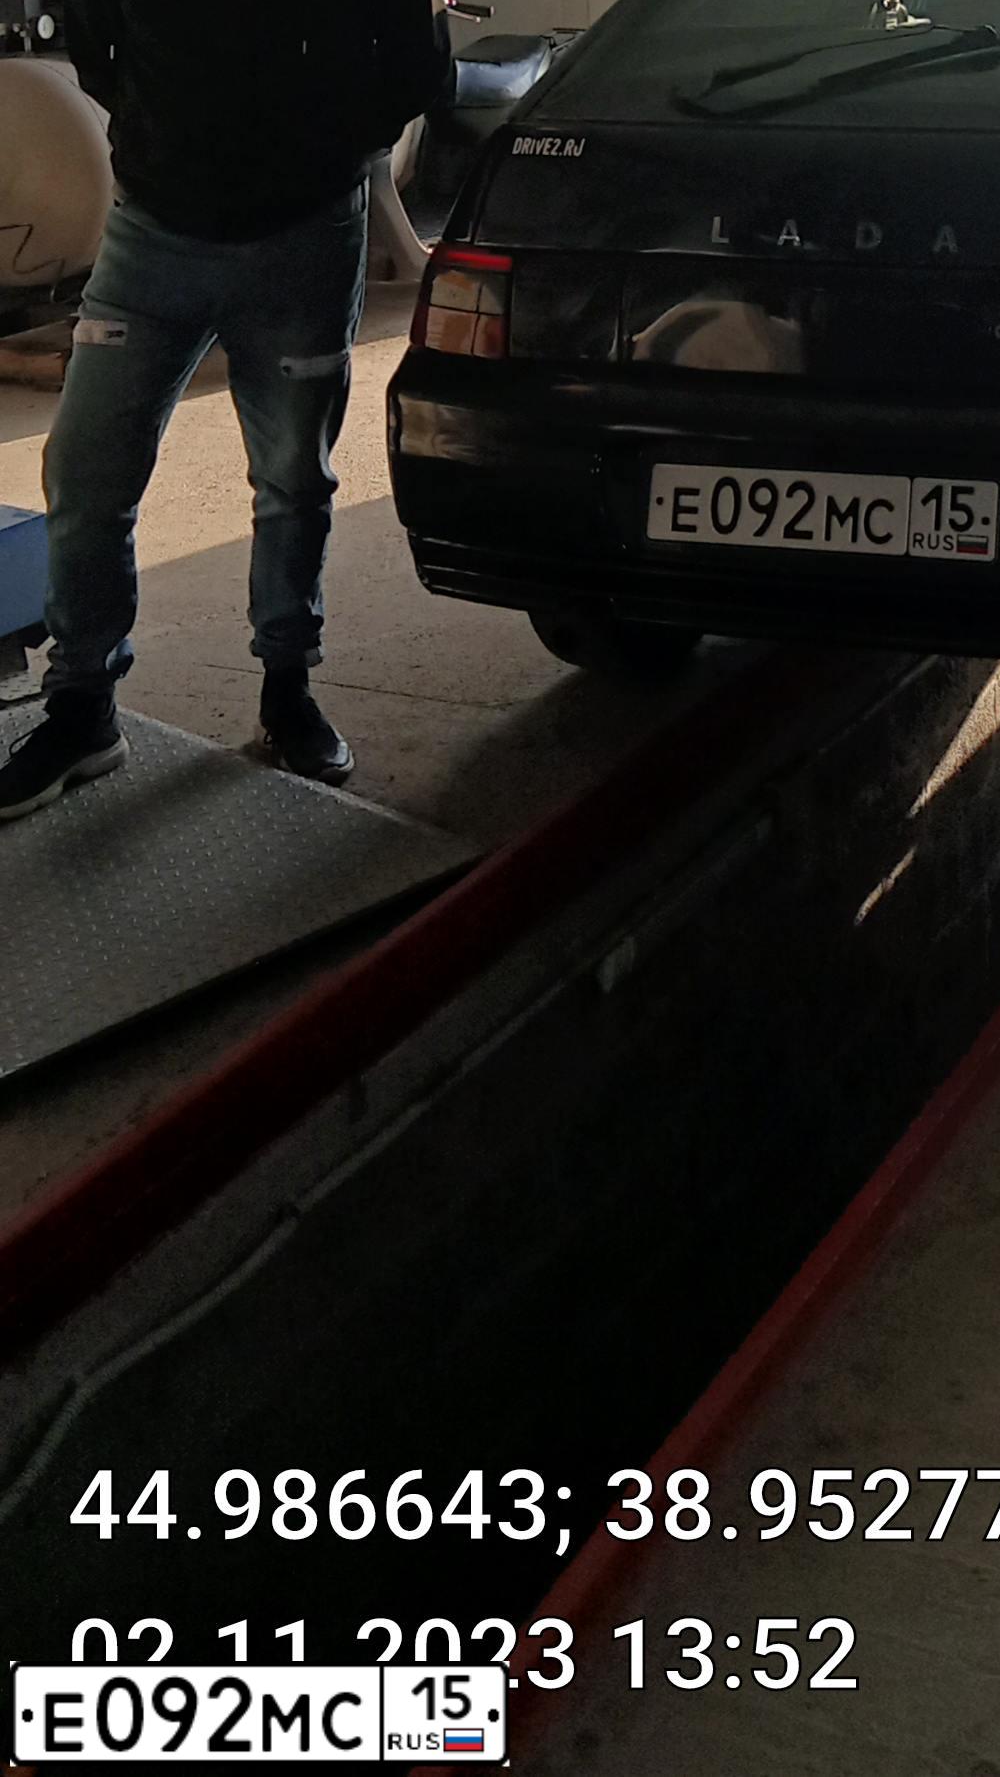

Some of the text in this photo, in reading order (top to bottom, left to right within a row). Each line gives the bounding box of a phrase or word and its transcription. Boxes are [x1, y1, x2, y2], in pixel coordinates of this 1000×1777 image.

[711, 216, 958, 253] LADA
[671, 476, 975, 545] Е092МС 15
[912, 533, 955, 551] RUS
